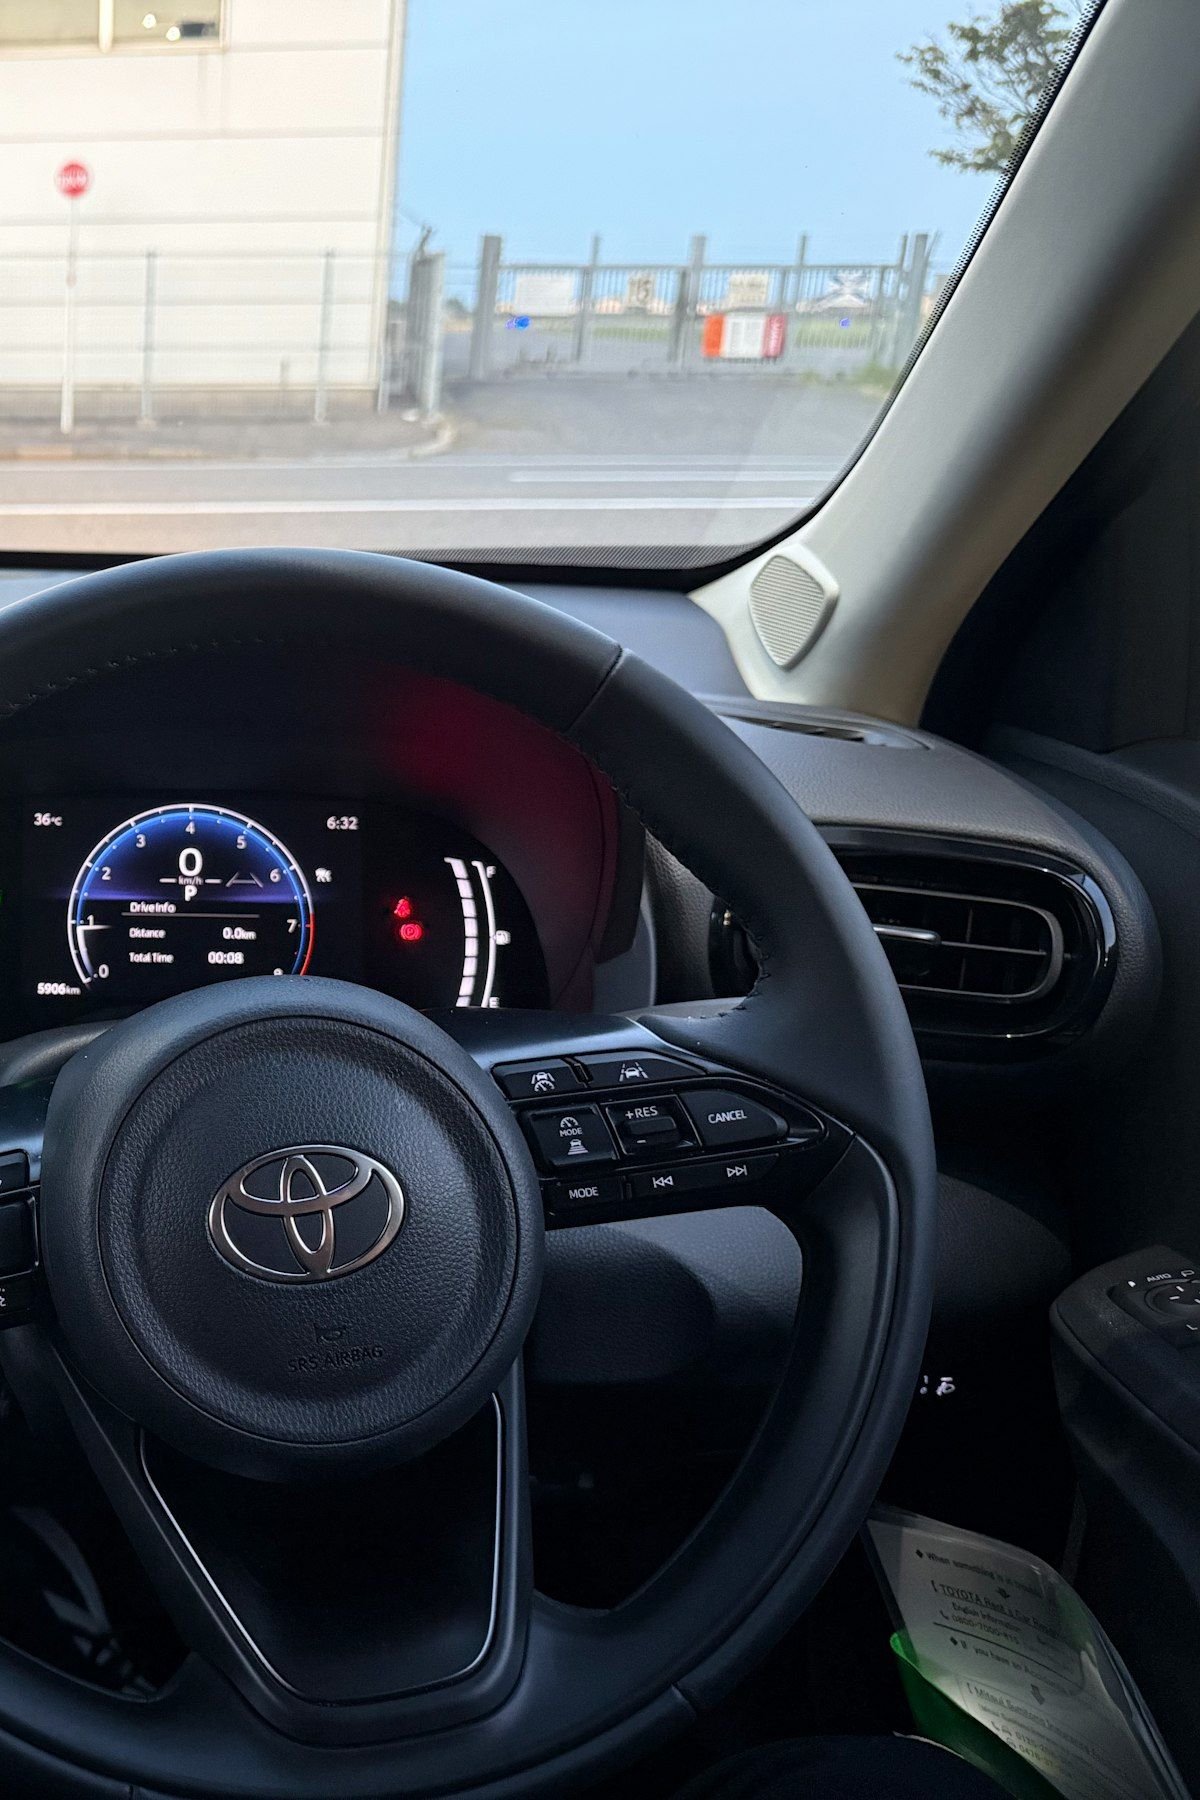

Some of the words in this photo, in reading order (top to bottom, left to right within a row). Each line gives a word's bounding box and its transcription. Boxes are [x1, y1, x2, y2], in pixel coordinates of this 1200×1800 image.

[185, 821, 195, 834] 4
[326, 816, 359, 830] 6:32
[136, 834, 146, 848] 3
[236, 835, 247, 849] 5
[178, 847, 203, 877] 0
[101, 866, 112, 880] 2
[269, 868, 281, 882] 6
[178, 875, 203, 886] km/h
[184, 886, 198, 901] P
[130, 901, 155, 913] Drive
[156, 901, 176, 913] Info
[86, 914, 95, 926] 1
[287, 919, 298, 933] 7
[129, 927, 166, 939] Distance
[129, 952, 151, 963] Total
[152, 952, 174, 963] Time
[207, 951, 244, 964] 00:08
[99, 963, 110, 978] 0
[707, 1109, 748, 1125] CANCEL
[559, 1125, 583, 1137] MODE
[568, 1185, 599, 1199] MODE
[1146, 1272, 1172, 1283] AUTO
[287, 1353, 318, 1373] SRS
[324, 1344, 385, 1369] AIRBAG
[939, 1583, 982, 1604] TOYOTA
